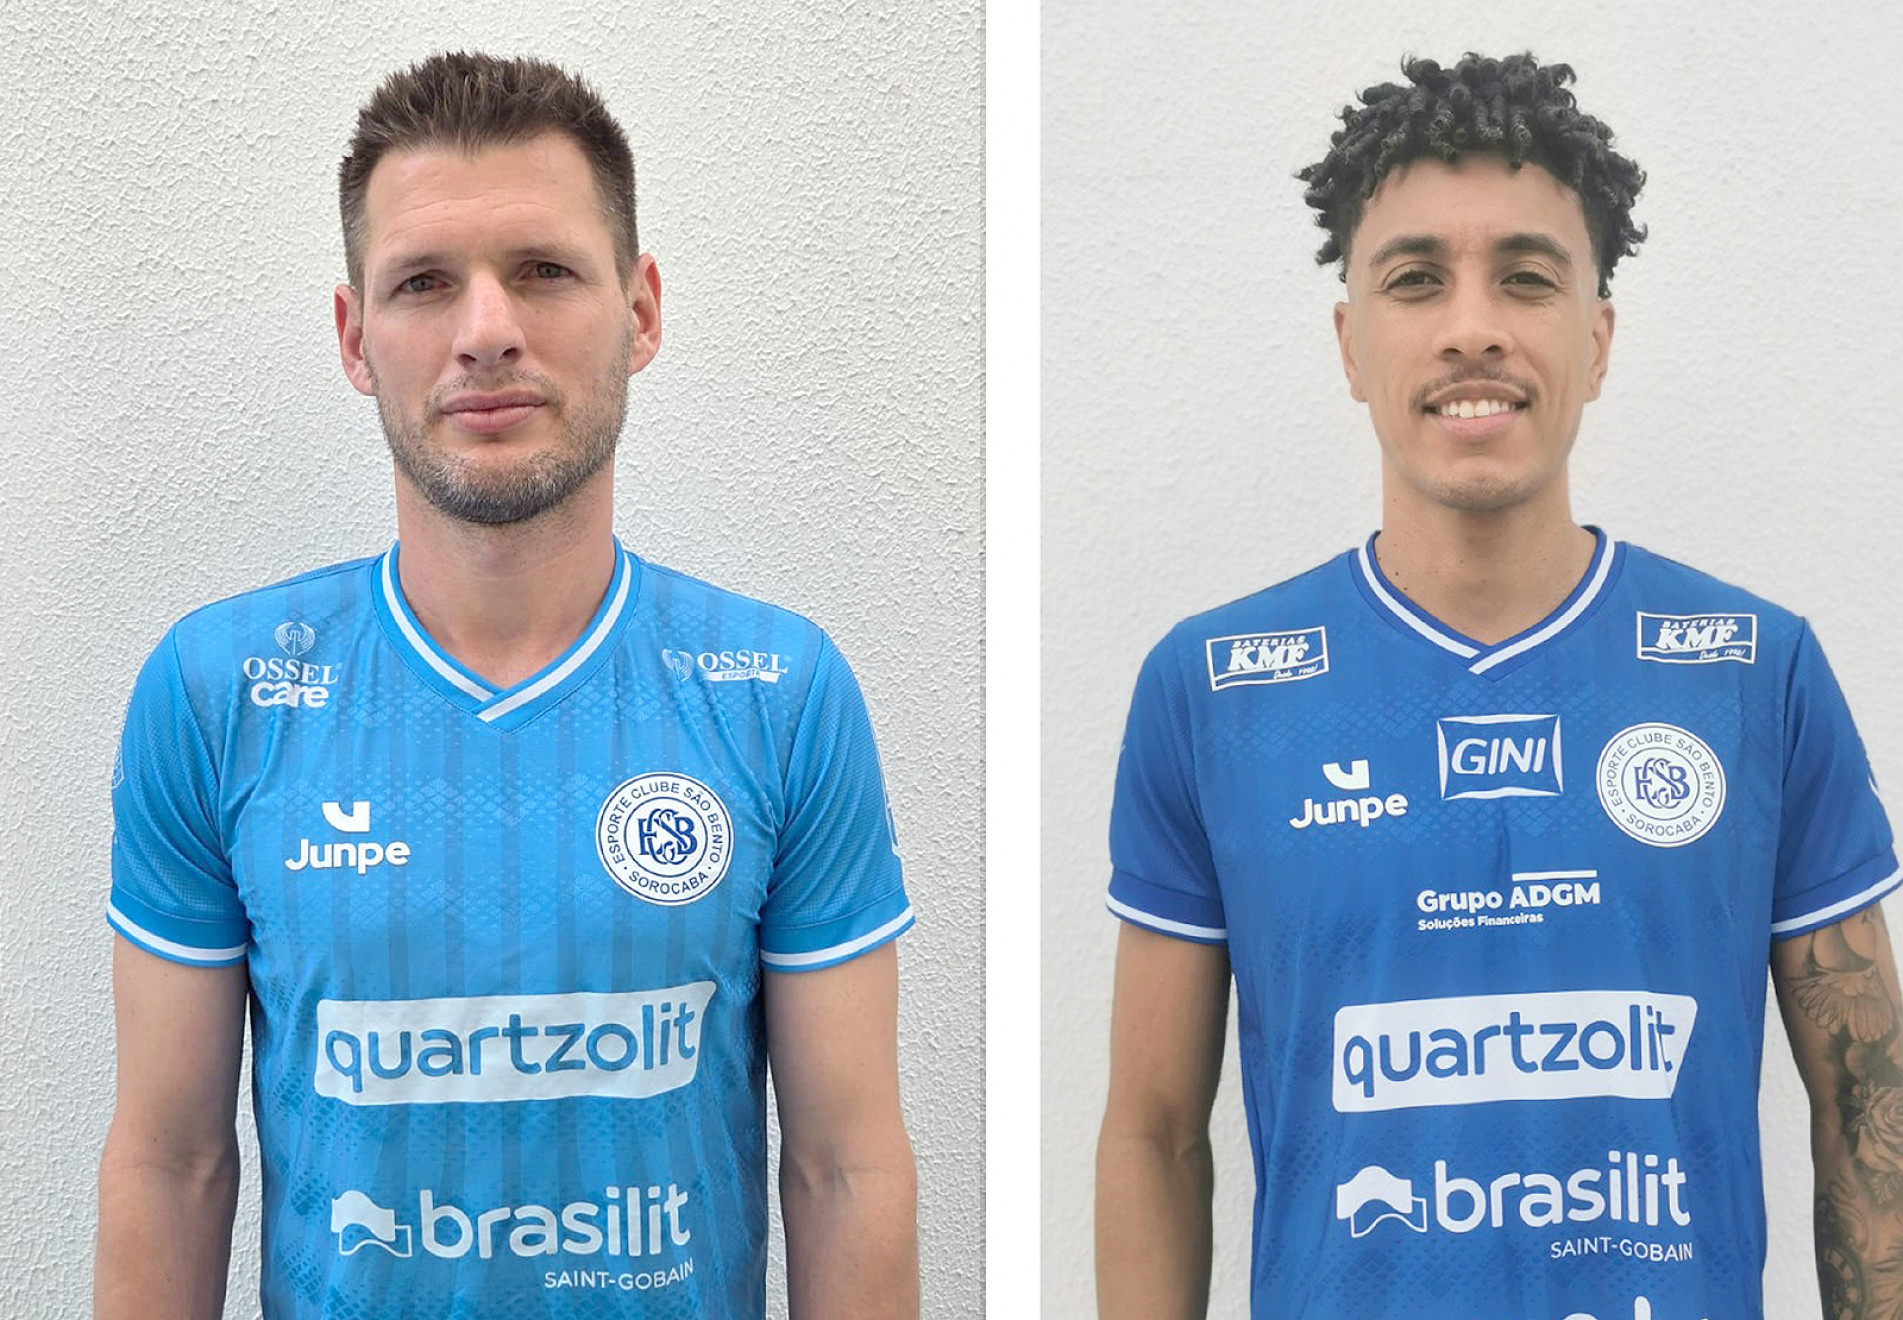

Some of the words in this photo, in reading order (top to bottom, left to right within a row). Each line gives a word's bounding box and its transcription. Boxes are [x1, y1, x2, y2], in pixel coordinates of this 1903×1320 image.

[1655, 624, 1739, 650] KMF
[243, 656, 339, 686] OSSEL
[697, 650, 788, 674] OSSEL
[1227, 642, 1310, 672] KMF
[250, 681, 329, 709] care
[1451, 737, 1547, 775] GINI
[1606, 746, 1629, 807] ESPORTE
[1626, 732, 1673, 749] CLUBE
[1675, 738, 1703, 761] SÃO
[1699, 761, 1716, 808] BENTO
[607, 796, 633, 864] ESPORTE
[630, 781, 680, 799] CLUBE
[683, 786, 711, 811] SÃO
[707, 812, 723, 863] BENTO
[1289, 793, 1409, 829] Junpe
[1626, 814, 1703, 837] SOROCABA
[284, 838, 411, 875] Junpe
[628, 870, 709, 895] SOROCABA
[1416, 889, 1503, 913] Grupo
[1509, 882, 1601, 909] ADGM
[1417, 916, 1476, 931] Soluções
[1477, 912, 1544, 927] Financeiras
[325, 1001, 697, 1093] quartzolit
[1343, 1004, 1676, 1098] quartzolit
[1434, 1150, 1691, 1234] brasilit
[419, 1183, 691, 1259] brasilit
[1550, 1236, 1694, 1262] SAINT-GOBAIN
[544, 1258, 694, 1290] SAINT-GOBAIN
